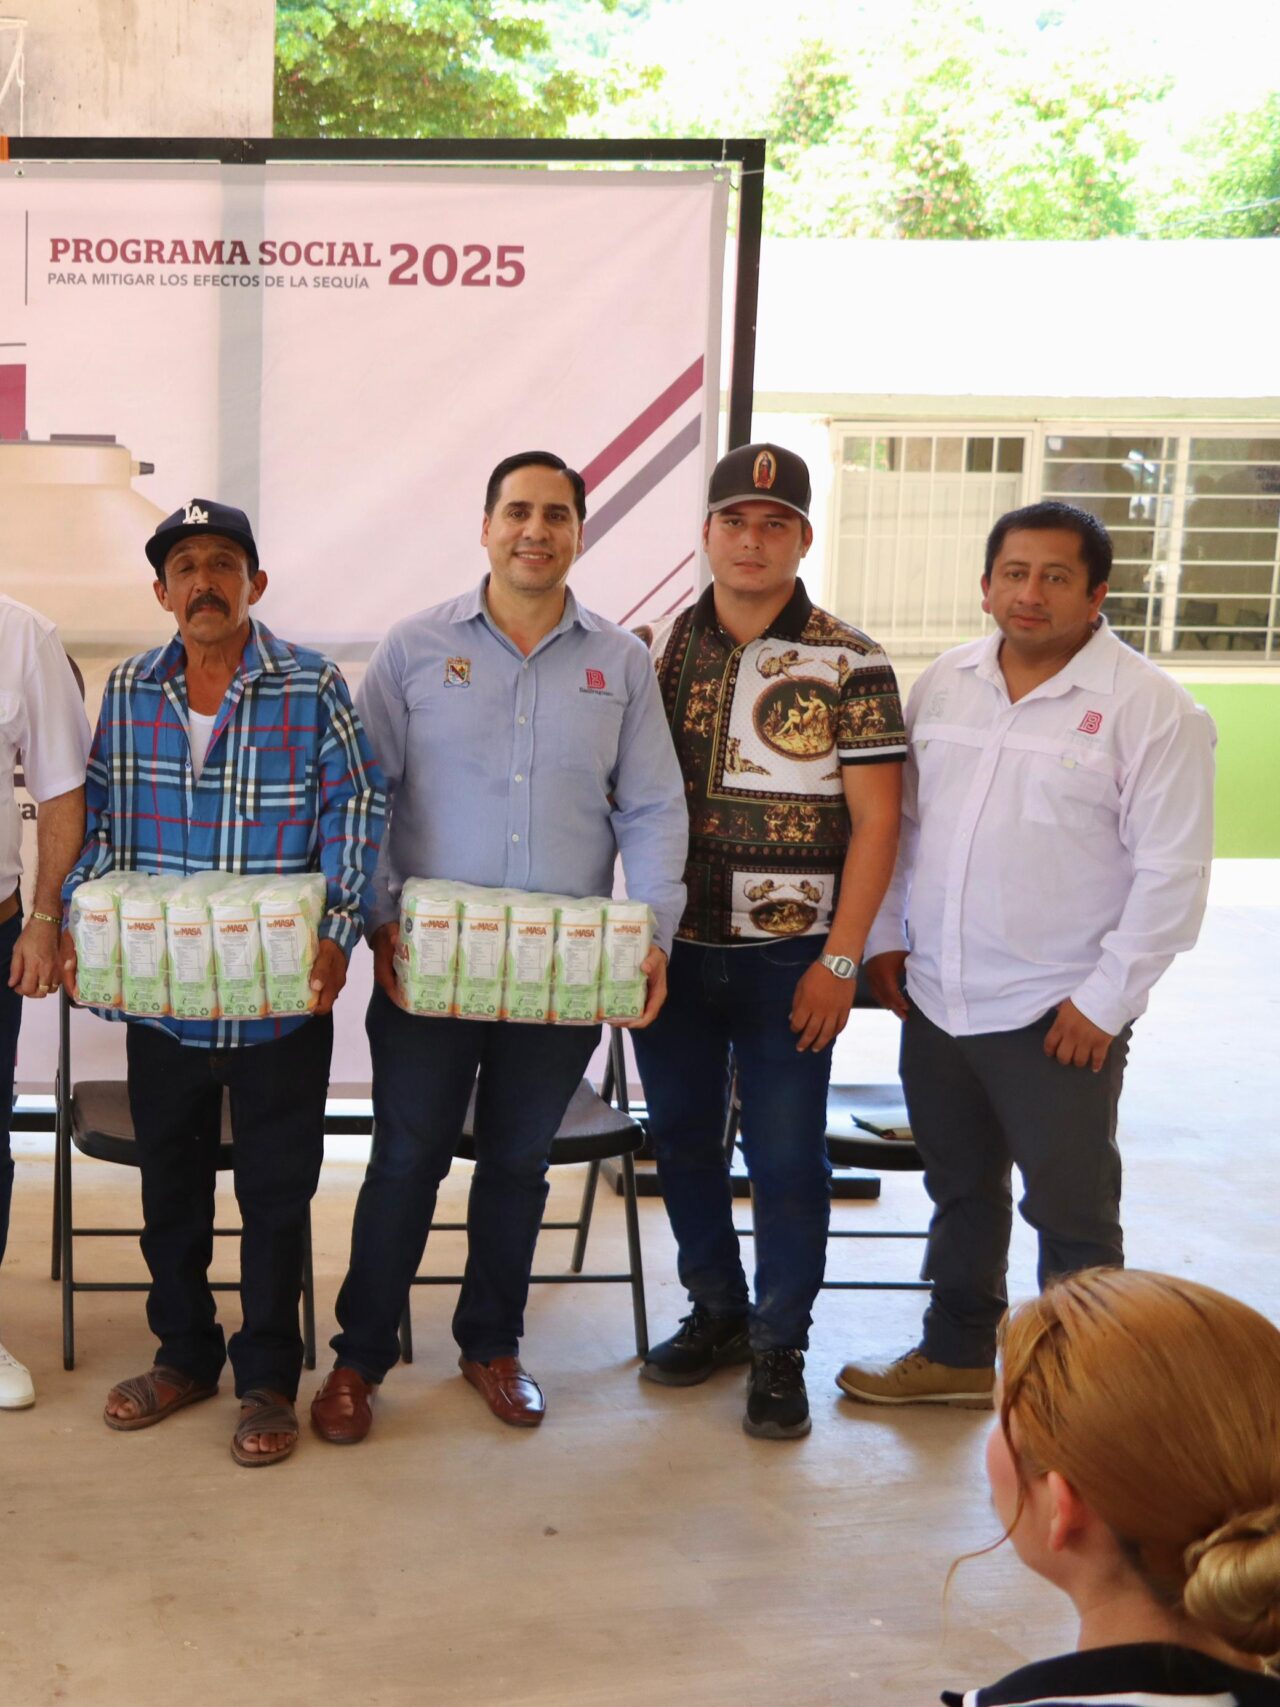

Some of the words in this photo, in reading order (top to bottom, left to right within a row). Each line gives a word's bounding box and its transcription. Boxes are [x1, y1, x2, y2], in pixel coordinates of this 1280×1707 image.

[48, 238, 251, 266] PROGRAMA
[258, 241, 382, 268] SOCIAL
[388, 243, 527, 288] 2025
[47, 272, 88, 287] PARA
[91, 273, 156, 287] MITIGAR
[160, 273, 189, 287] LOS
[193, 274, 261, 288] EFECTOS
[265, 275, 285, 288] DE
[290, 275, 309, 289] LA
[313, 274, 370, 290] SEQUÍA
[182, 501, 209, 525] LA
